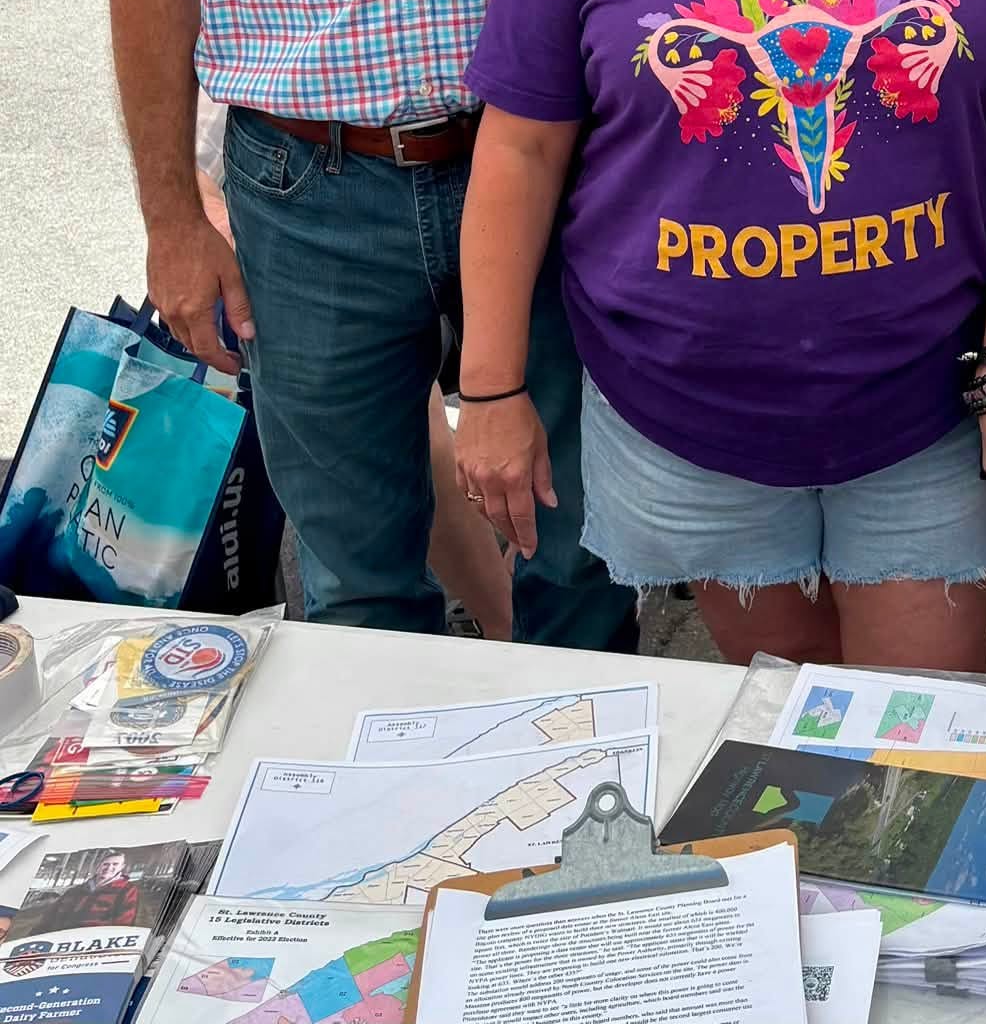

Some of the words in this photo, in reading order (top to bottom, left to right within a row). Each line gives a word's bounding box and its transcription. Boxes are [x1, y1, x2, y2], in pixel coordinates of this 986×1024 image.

[656, 191, 952, 279] PROPERTY
[163, 639, 202, 665] STD
[223, 916, 282, 925] Legislative
[284, 918, 330, 927] Districts
[236, 909, 286, 918] Lawrence
[288, 911, 327, 920] County
[56, 935, 140, 953] BLAKE
[61, 961, 99, 970] Congress
[0, 997, 102, 1013] econd-Generation
[3, 1012, 36, 1023] Dairy
[38, 1007, 83, 1019] Farmer
